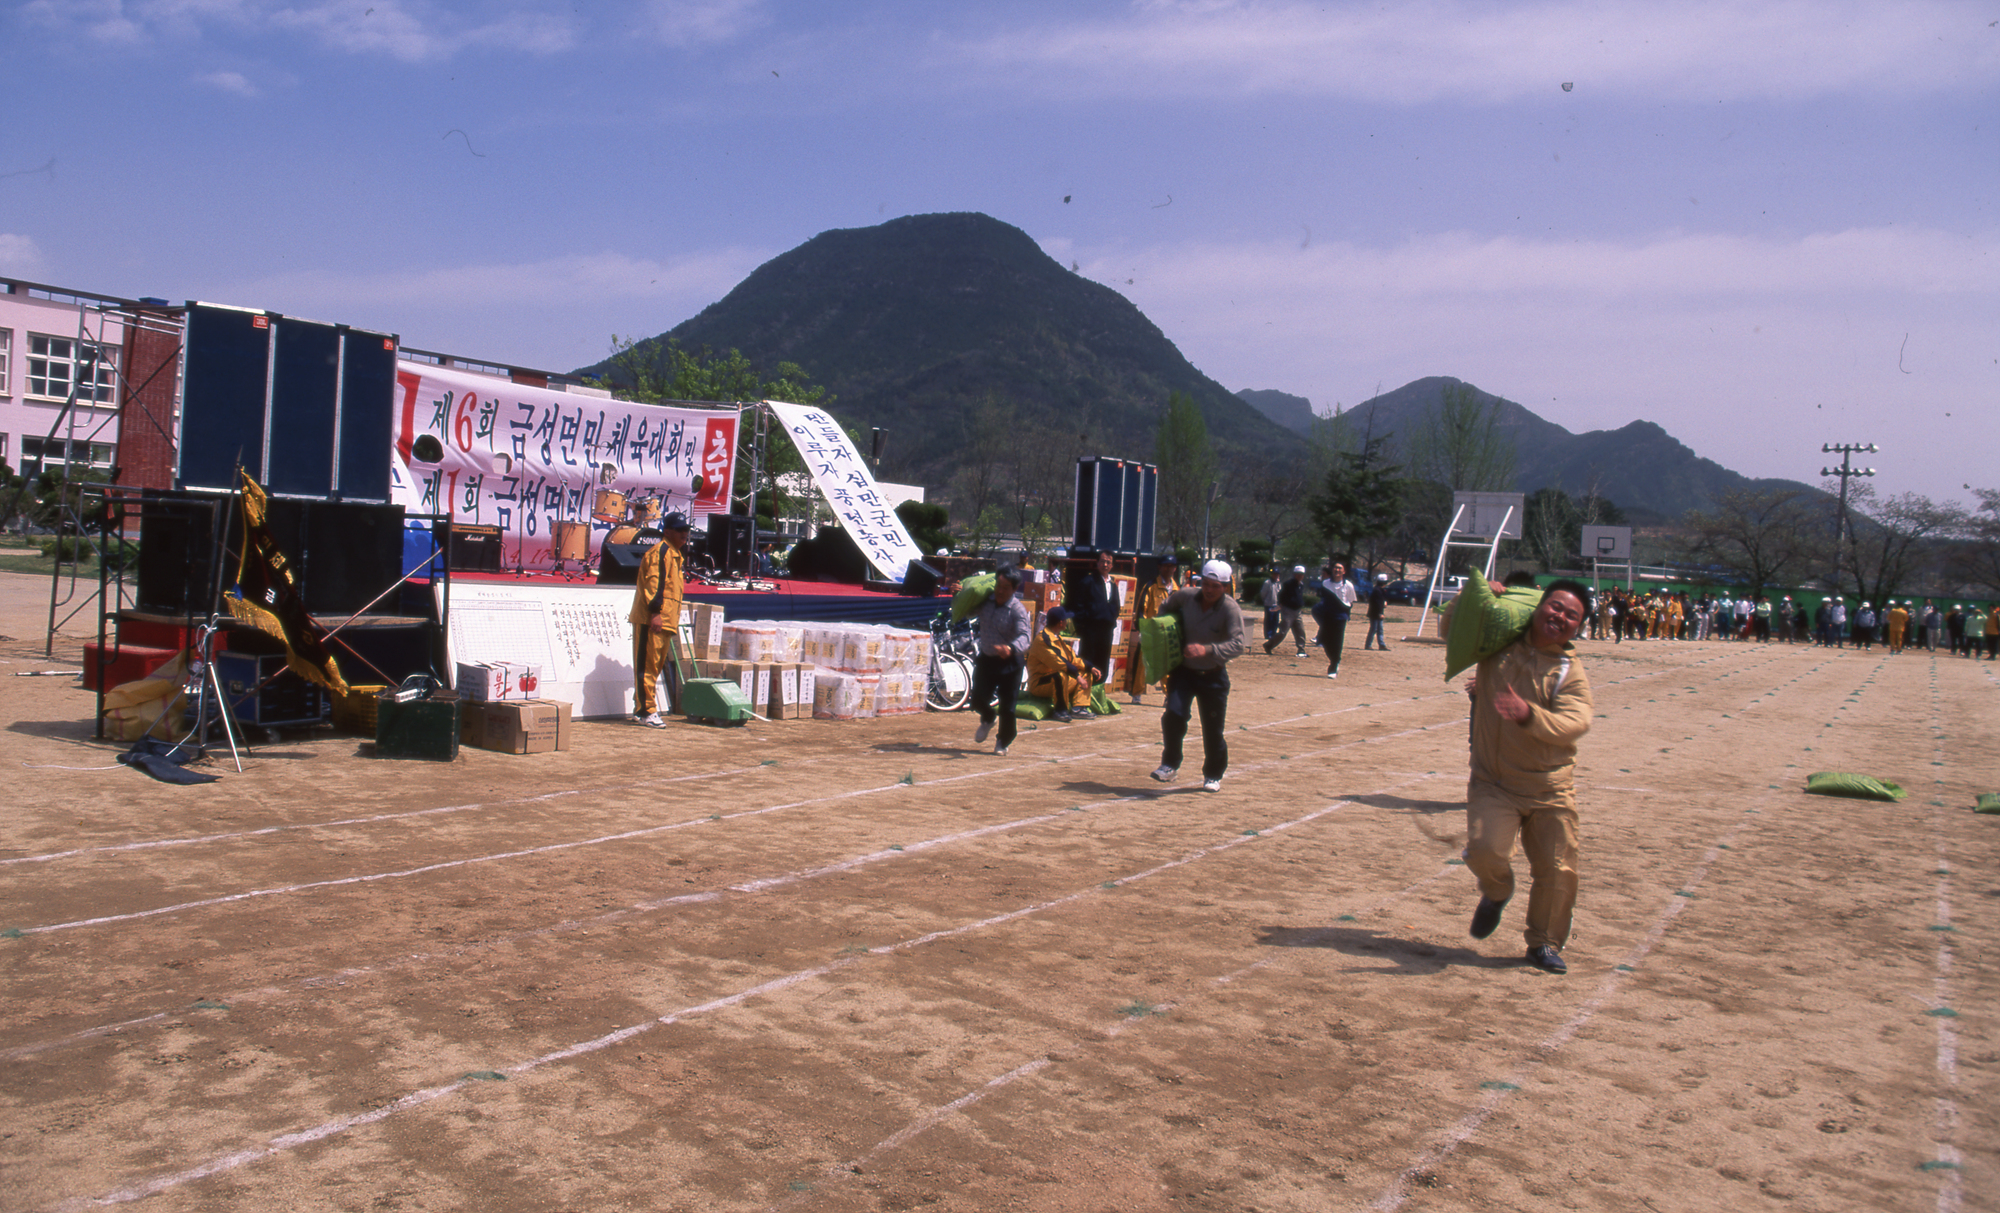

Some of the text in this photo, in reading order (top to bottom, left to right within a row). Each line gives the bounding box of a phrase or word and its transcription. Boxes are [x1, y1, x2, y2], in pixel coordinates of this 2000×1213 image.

[428, 390, 697, 478] 제6회 금성면민 체육대회 및
[704, 429, 728, 501] 축
[421, 468, 484, 524] 제1회
[793, 424, 896, 564] 이루자 풍년농사
[803, 411, 907, 548] 만들자 십만군민
